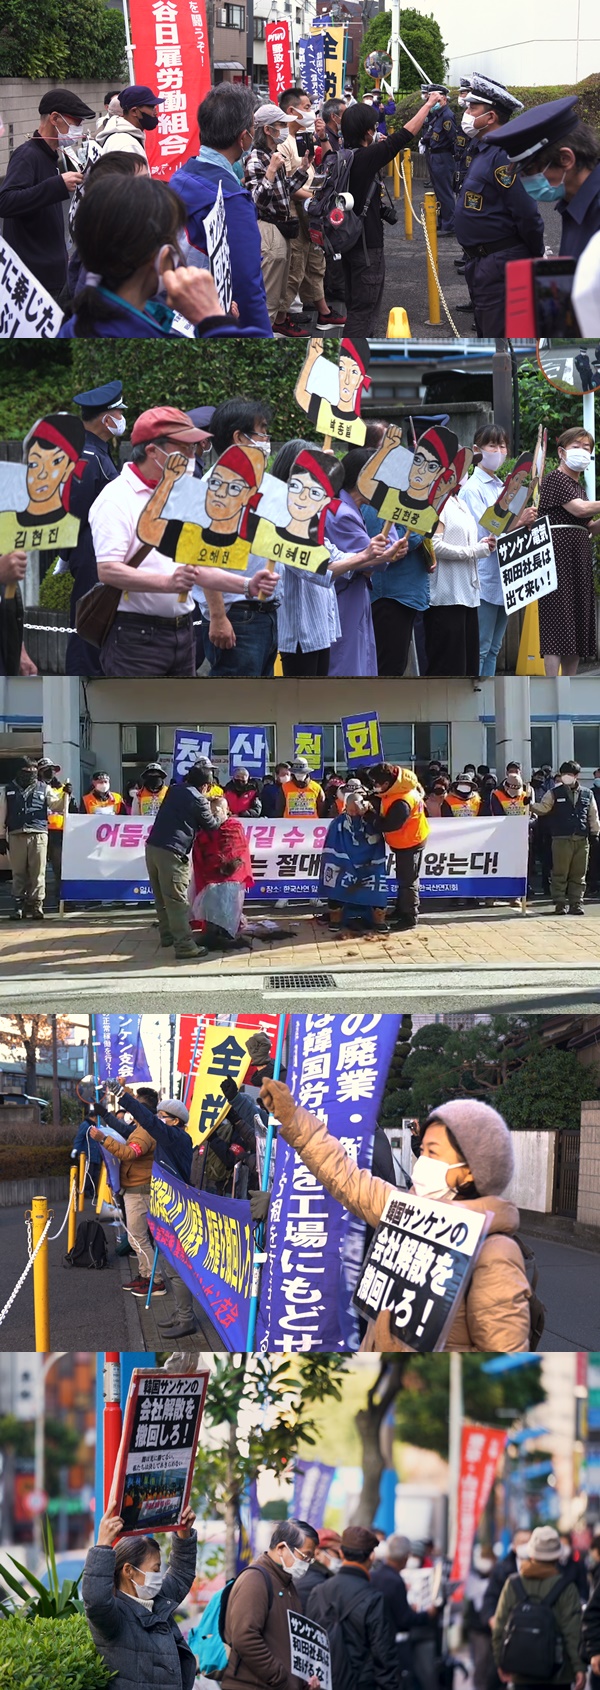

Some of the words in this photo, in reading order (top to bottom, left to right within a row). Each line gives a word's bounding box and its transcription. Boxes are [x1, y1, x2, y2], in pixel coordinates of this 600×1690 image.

[499, 523, 548, 561] サンケン電気
[502, 548, 551, 586] 和田社長は
[230, 733, 265, 768] 산
[295, 732, 321, 769] 철
[346, 720, 379, 758] 회
[371, 1227, 454, 1297] 会社解散を
[143, 1379, 199, 1394] 韓国サンケンの
[140, 1397, 195, 1422] 会社解散を
[135, 1423, 190, 1447] 撤回しろ！
